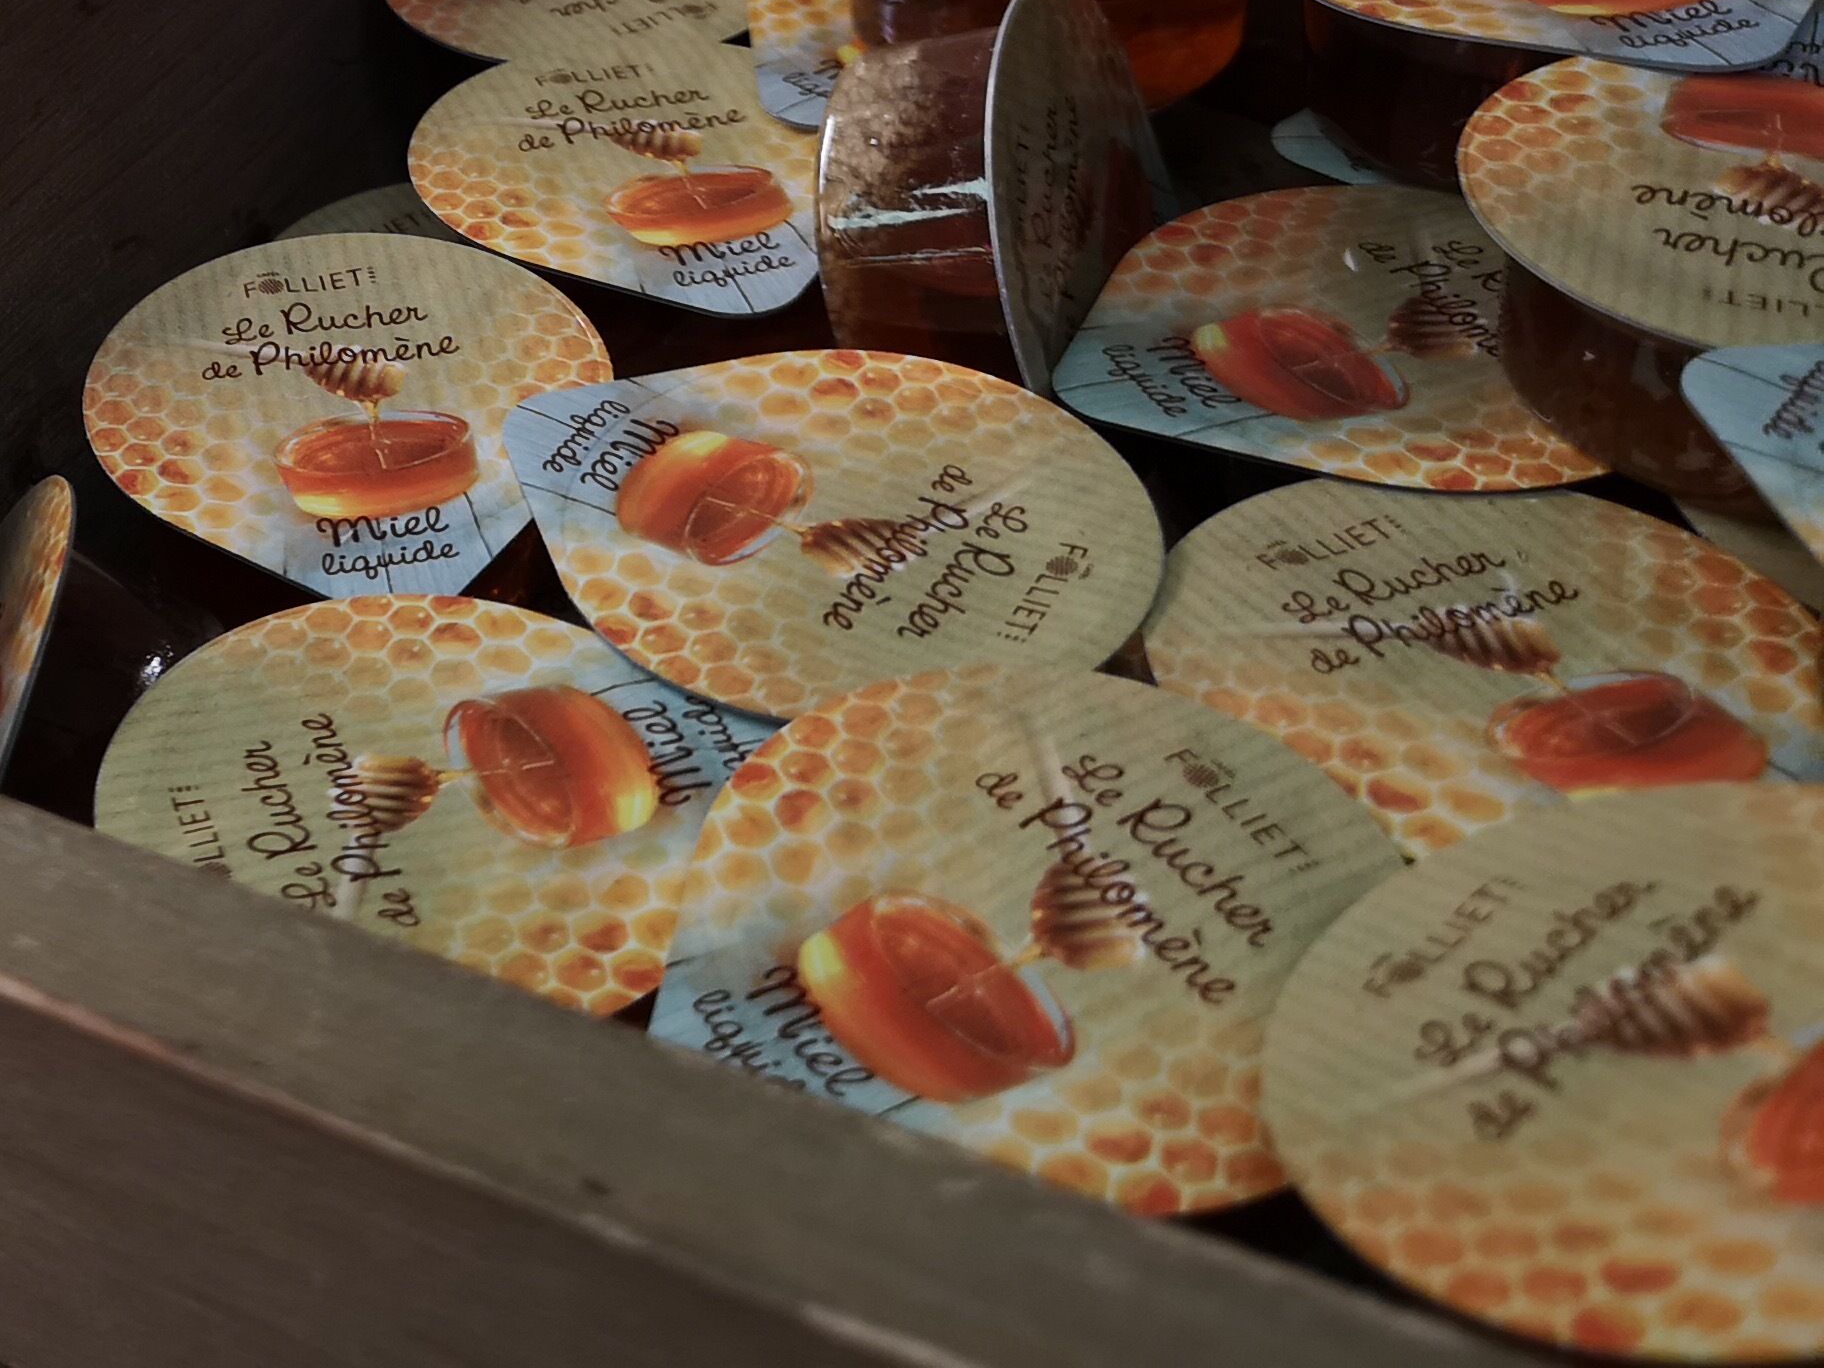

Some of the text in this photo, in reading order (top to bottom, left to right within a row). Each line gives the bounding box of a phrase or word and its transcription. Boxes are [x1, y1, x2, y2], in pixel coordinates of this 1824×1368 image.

[1592, 0, 1734, 32] Miel
[1618, 18, 1762, 50] liquide
[517, 106, 747, 153] de Philomène
[524, 87, 711, 121] Le Rucher
[657, 231, 781, 266] Miel
[1630, 182, 1824, 240] lomène
[243, 267, 364, 299] FOLLIET
[672, 256, 797, 288] liquide
[201, 334, 461, 381] de Philomène
[221, 301, 430, 345] Le Rucher
[1100, 341, 1191, 419] liquide
[1146, 335, 1243, 409] Miel
[541, 398, 631, 475] liquide
[579, 418, 681, 493] Miel
[314, 505, 451, 549] Miel
[320, 538, 462, 580] liquide
[820, 462, 973, 633] de Philomène
[896, 500, 1029, 642] Le Rucher
[1281, 547, 1507, 626] Le Rucher
[1310, 578, 1581, 675] de Philomène
[622, 698, 713, 808] Miel
[240, 737, 339, 911] Le Rucher
[299, 711, 423, 930] de Philomène
[1166, 746, 1308, 865] FOLLIET
[974, 769, 1239, 1007] de Philomène
[1061, 751, 1277, 950] Le Rucher
[745, 963, 877, 1099] Miel
